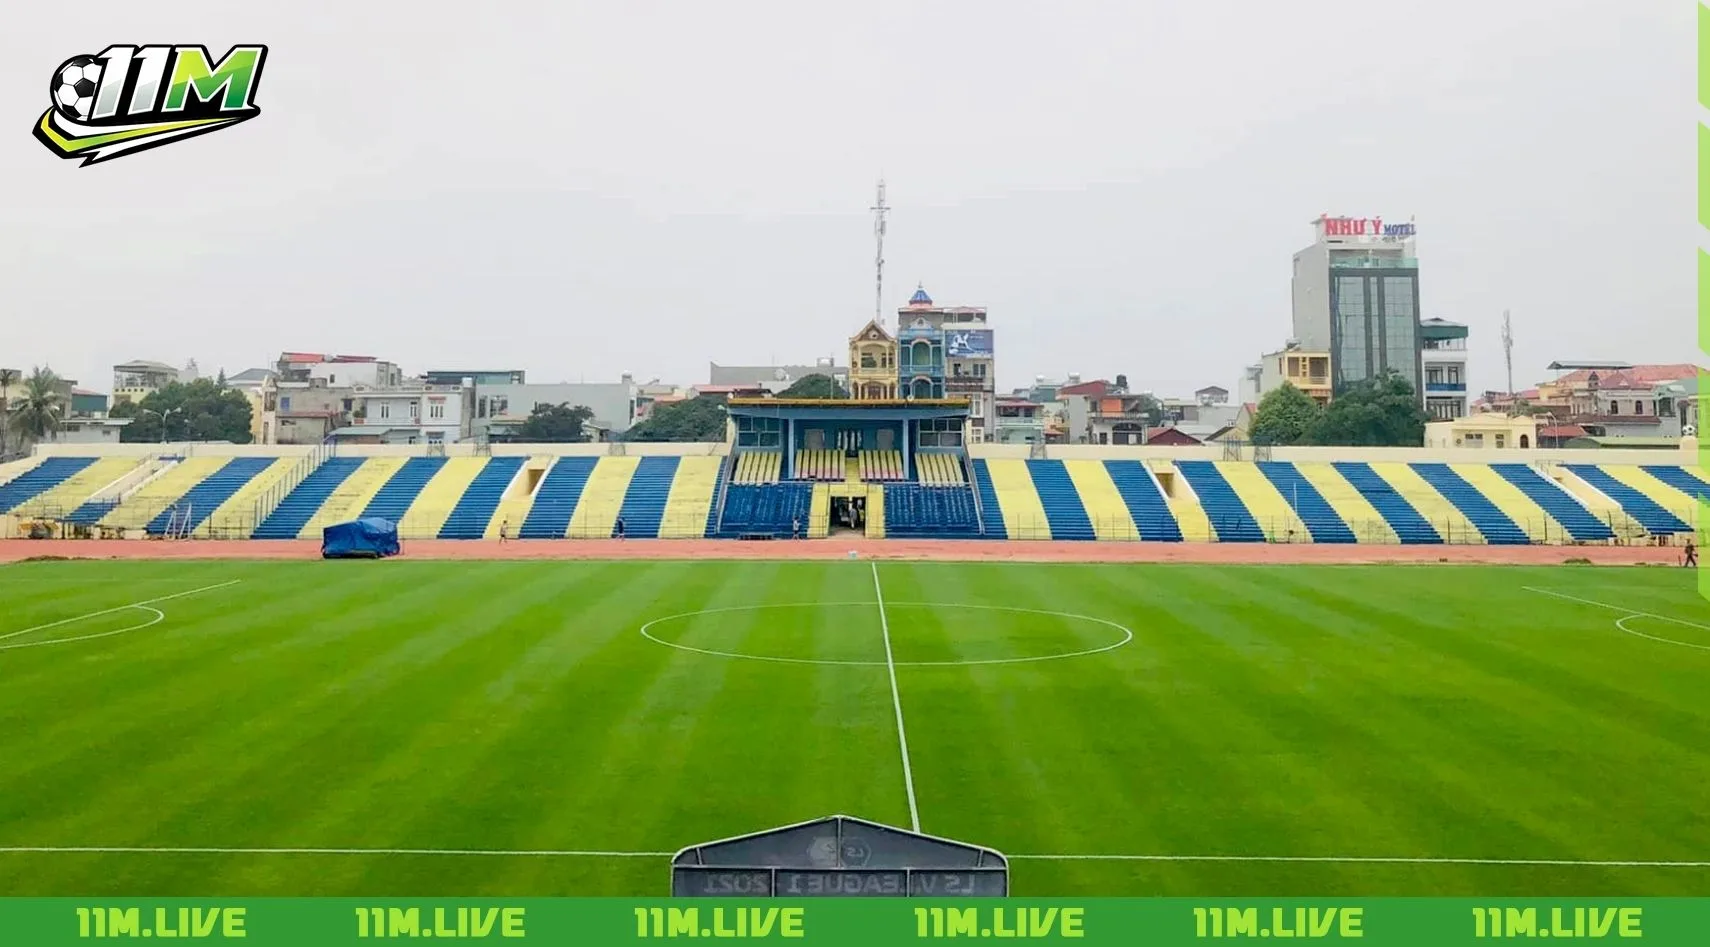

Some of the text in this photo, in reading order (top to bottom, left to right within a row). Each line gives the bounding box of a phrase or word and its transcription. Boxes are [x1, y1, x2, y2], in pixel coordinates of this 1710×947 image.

[1326, 215, 1416, 235] NHƯ Ý MOTEL
